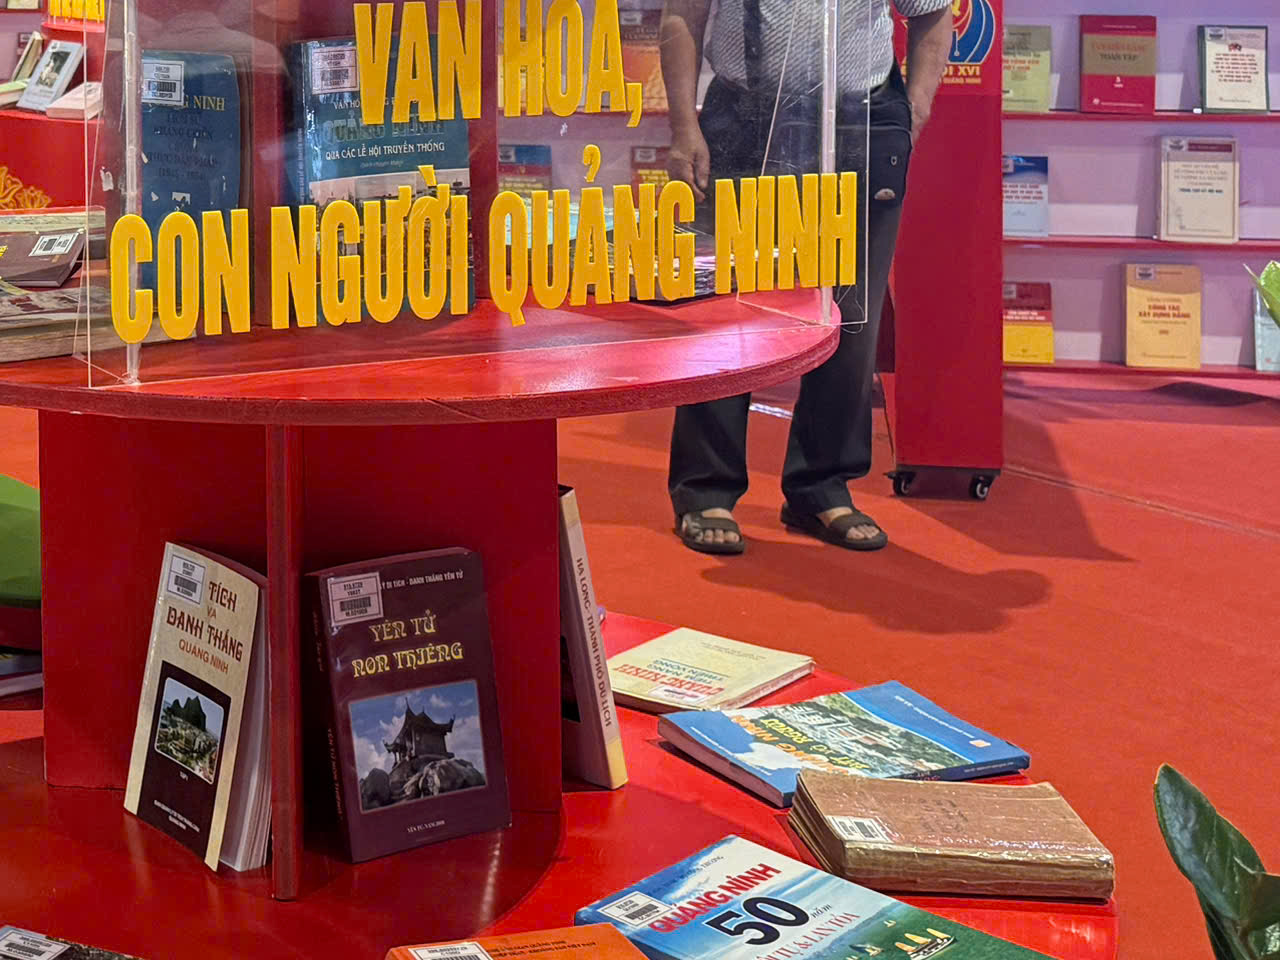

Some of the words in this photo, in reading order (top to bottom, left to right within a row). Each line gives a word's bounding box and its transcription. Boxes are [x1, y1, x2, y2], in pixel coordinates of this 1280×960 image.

[958, 65, 980, 76] XVI
[194, 95, 225, 112] NINH
[325, 149, 340, 161] QUA
[341, 146, 356, 159] CÁC
[358, 143, 368, 158] LỄ
[368, 145, 382, 157] HỘI
[383, 141, 415, 155] TRUYỀN
[417, 141, 445, 153] THỐNG
[110, 209, 251, 344] CON
[271, 165, 469, 330] NGƯỜI
[489, 144, 696, 327] QUẢNG
[715, 171, 857, 295] NINH
[209, 581, 237, 612] TÍCH
[167, 606, 204, 639] DANH
[207, 622, 243, 663] THẮNG
[369, 619, 406, 642] YÊN
[410, 609, 436, 634] TỬ
[210, 654, 229, 675] NINH
[352, 655, 390, 678] NON
[393, 642, 464, 670] THIÊNG
[705, 896, 810, 945] 50
[810, 904, 833, 919] năm
